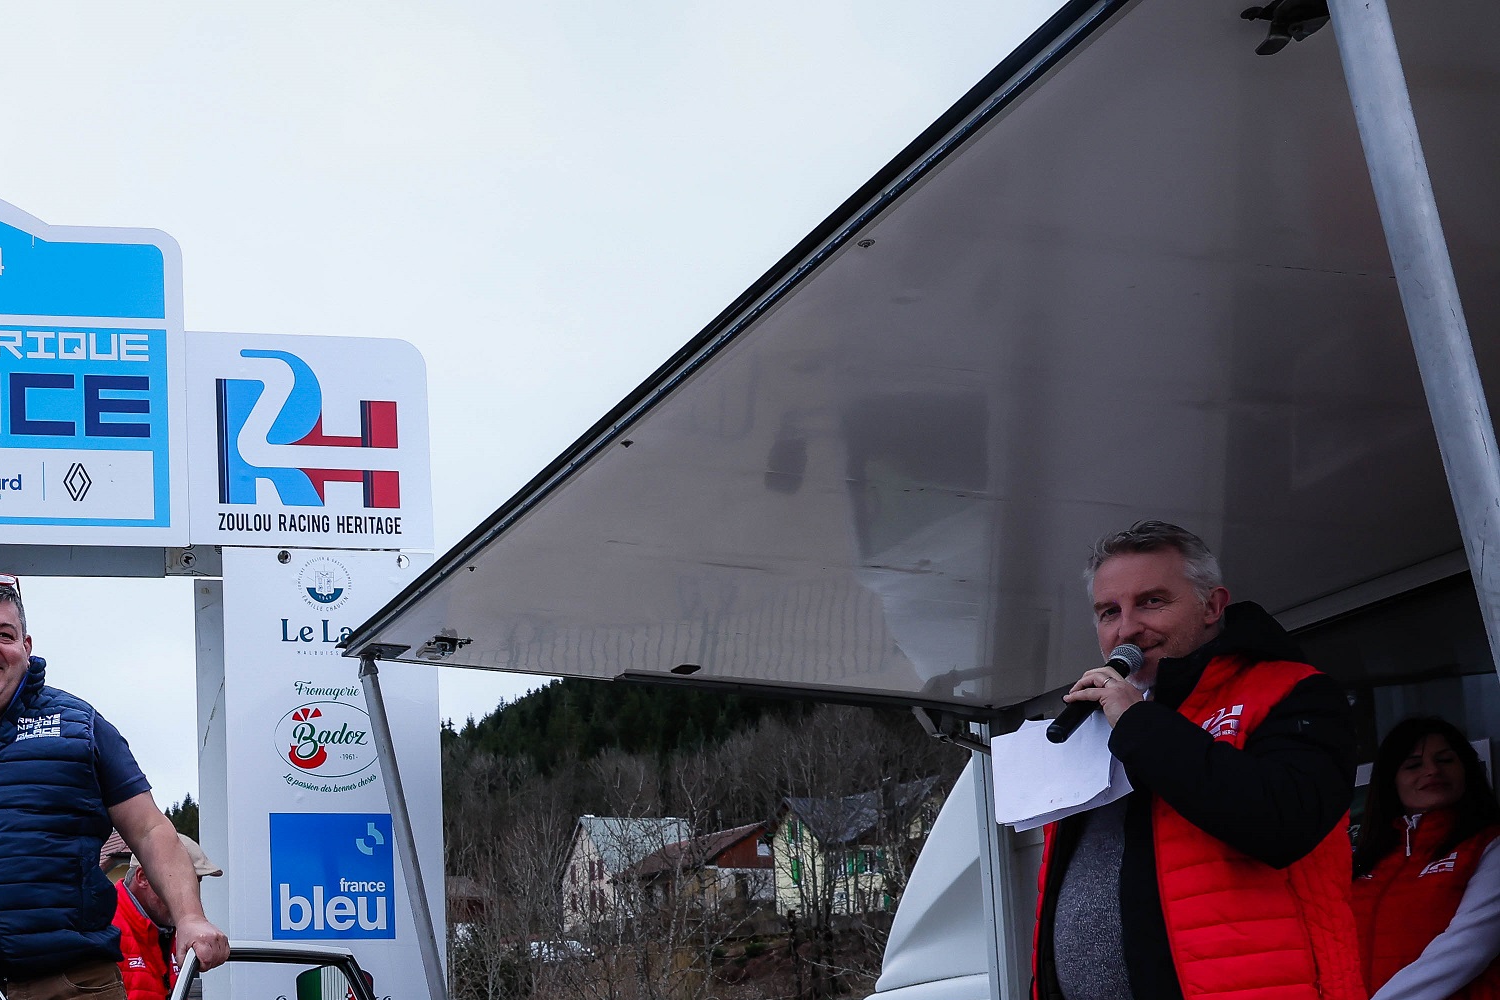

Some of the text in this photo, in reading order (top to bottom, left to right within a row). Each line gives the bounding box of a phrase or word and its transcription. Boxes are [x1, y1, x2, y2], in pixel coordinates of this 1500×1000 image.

[218, 513, 402, 534] ZOULOU RACING HERITAGE
[281, 618, 354, 642] Le La
[294, 681, 360, 700] Fromagerie
[293, 722, 368, 758] Badoz
[283, 773, 376, 792] La passion des bonnes choses
[340, 878, 385, 892] france
[280, 883, 386, 930] bleu
